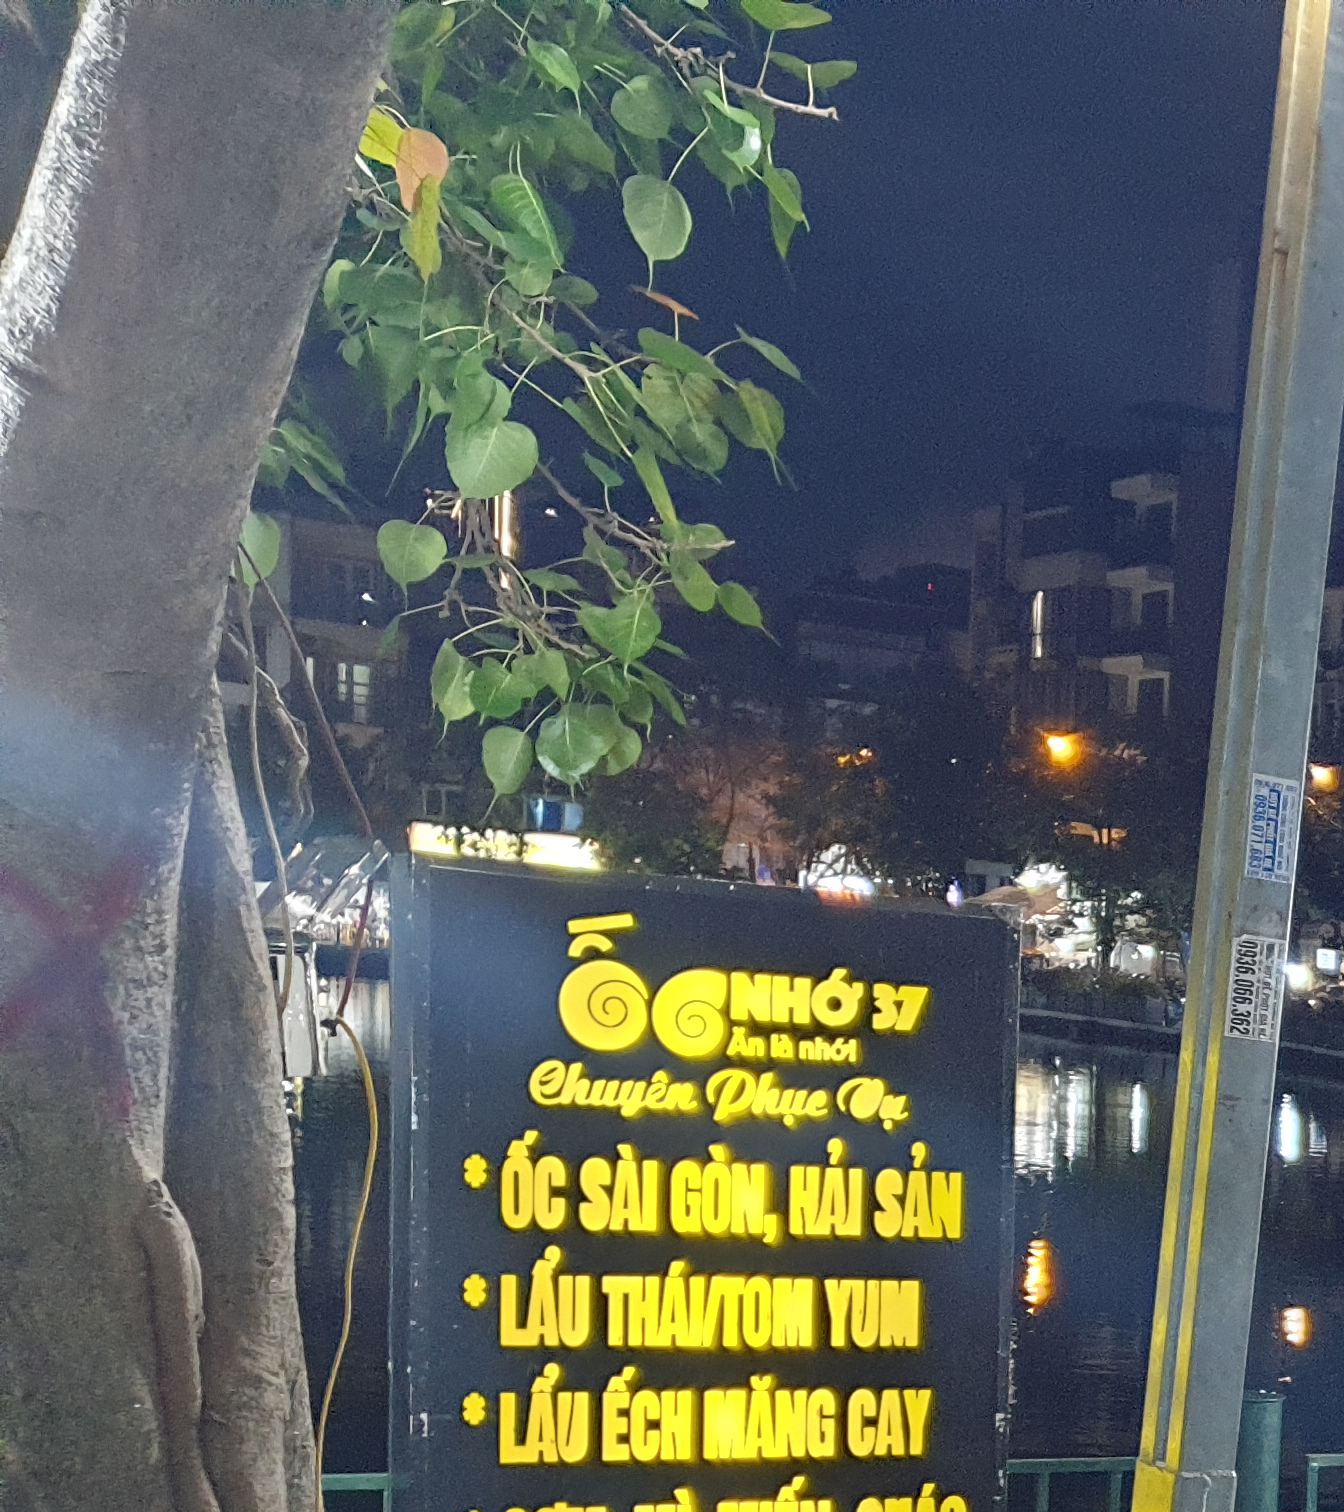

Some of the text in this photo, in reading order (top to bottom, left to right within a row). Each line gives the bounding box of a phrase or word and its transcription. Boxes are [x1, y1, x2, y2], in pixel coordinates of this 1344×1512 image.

[729, 967, 865, 1028] NHỚ
[872, 983, 929, 1031] 37
[1229, 940, 1259, 1036] 0936.066.362
[528, 1059, 698, 1117] Chuyên
[705, 1067, 828, 1127] Phục
[770, 1034, 793, 1058] là
[500, 1130, 963, 1244] ỐC SÀI GÒN, HẢI SẢN
[500, 1244, 591, 1347] LẨU
[824, 1278, 921, 1348] YUM
[499, 1362, 931, 1464] LẨU ẾCH MĂNG CAY
